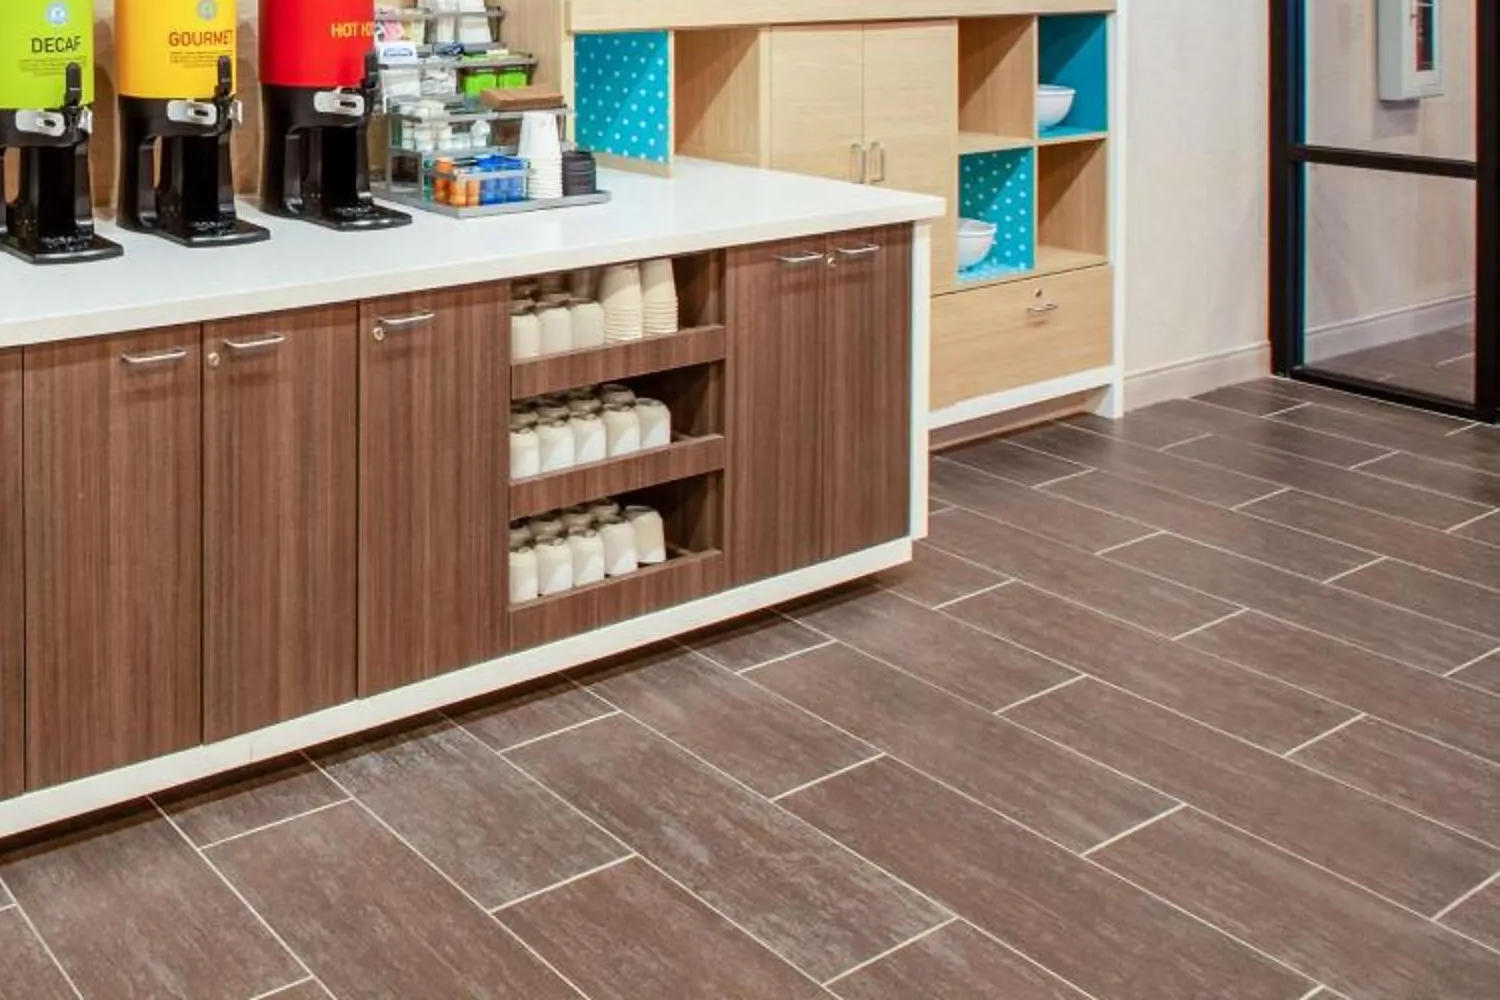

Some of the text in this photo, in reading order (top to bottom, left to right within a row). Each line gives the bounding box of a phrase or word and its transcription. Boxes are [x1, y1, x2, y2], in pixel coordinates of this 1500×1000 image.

[168, 29, 233, 47] GOURMET
[331, 22, 357, 38] HOT
[31, 35, 82, 53] DECAF
